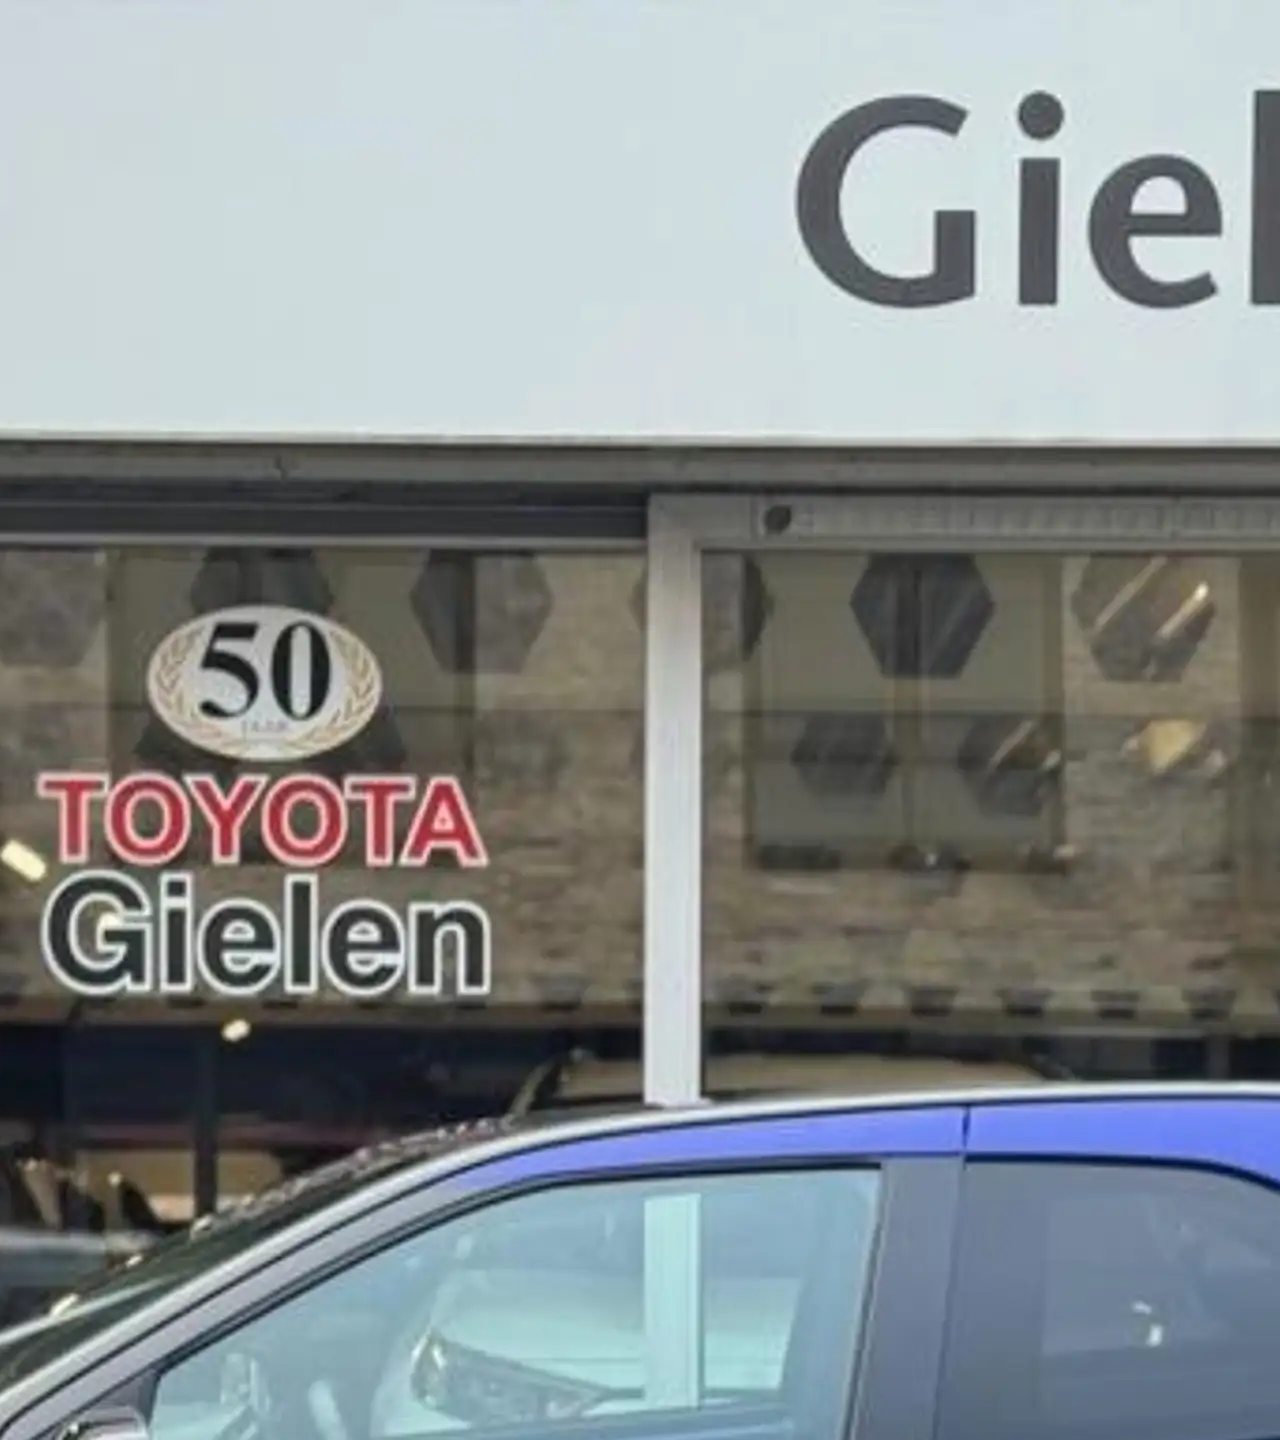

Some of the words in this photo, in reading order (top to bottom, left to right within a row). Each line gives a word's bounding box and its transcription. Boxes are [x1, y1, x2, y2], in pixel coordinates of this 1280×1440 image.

[197, 620, 331, 720] 50
[37, 772, 489, 867] TOYOTA
[41, 870, 492, 994] Gielen
